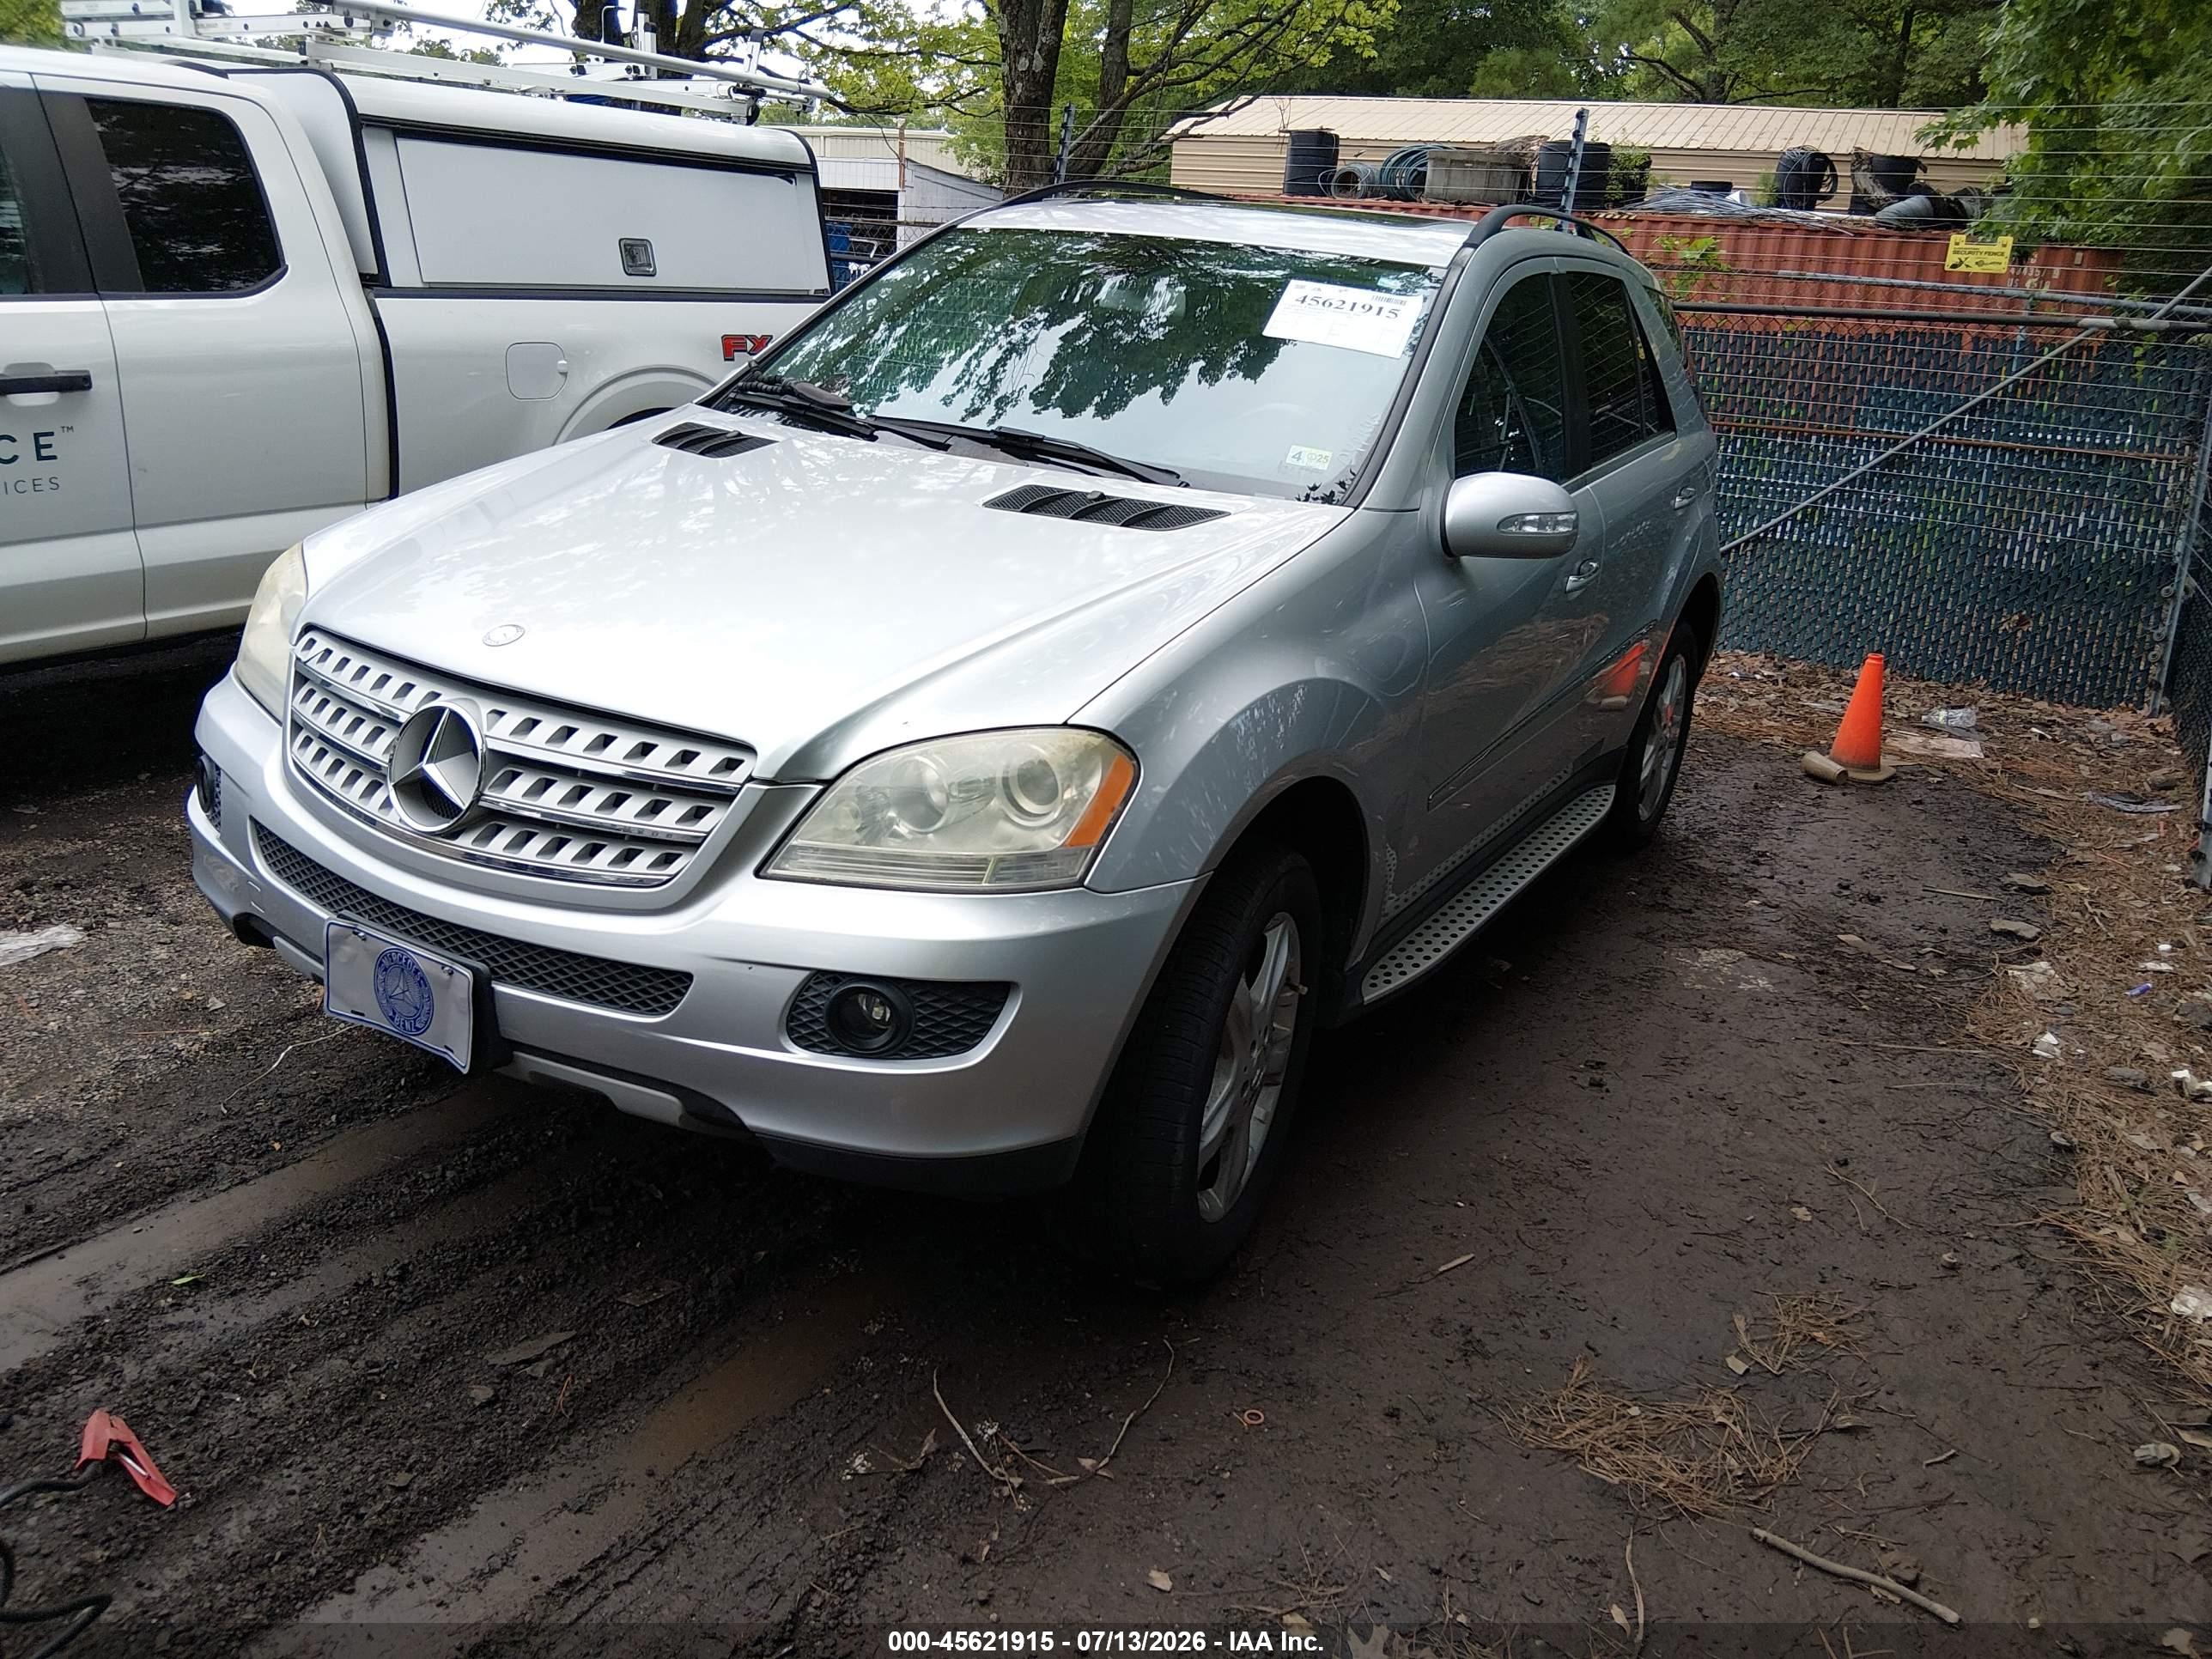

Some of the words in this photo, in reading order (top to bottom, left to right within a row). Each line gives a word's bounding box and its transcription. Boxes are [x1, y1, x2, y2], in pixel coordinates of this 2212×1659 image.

[1295, 295, 1401, 319] 45621915
[1291, 451, 1303, 462] 4
[1318, 453, 1330, 464] 25
[395, 1015, 417, 1032] BENZ
